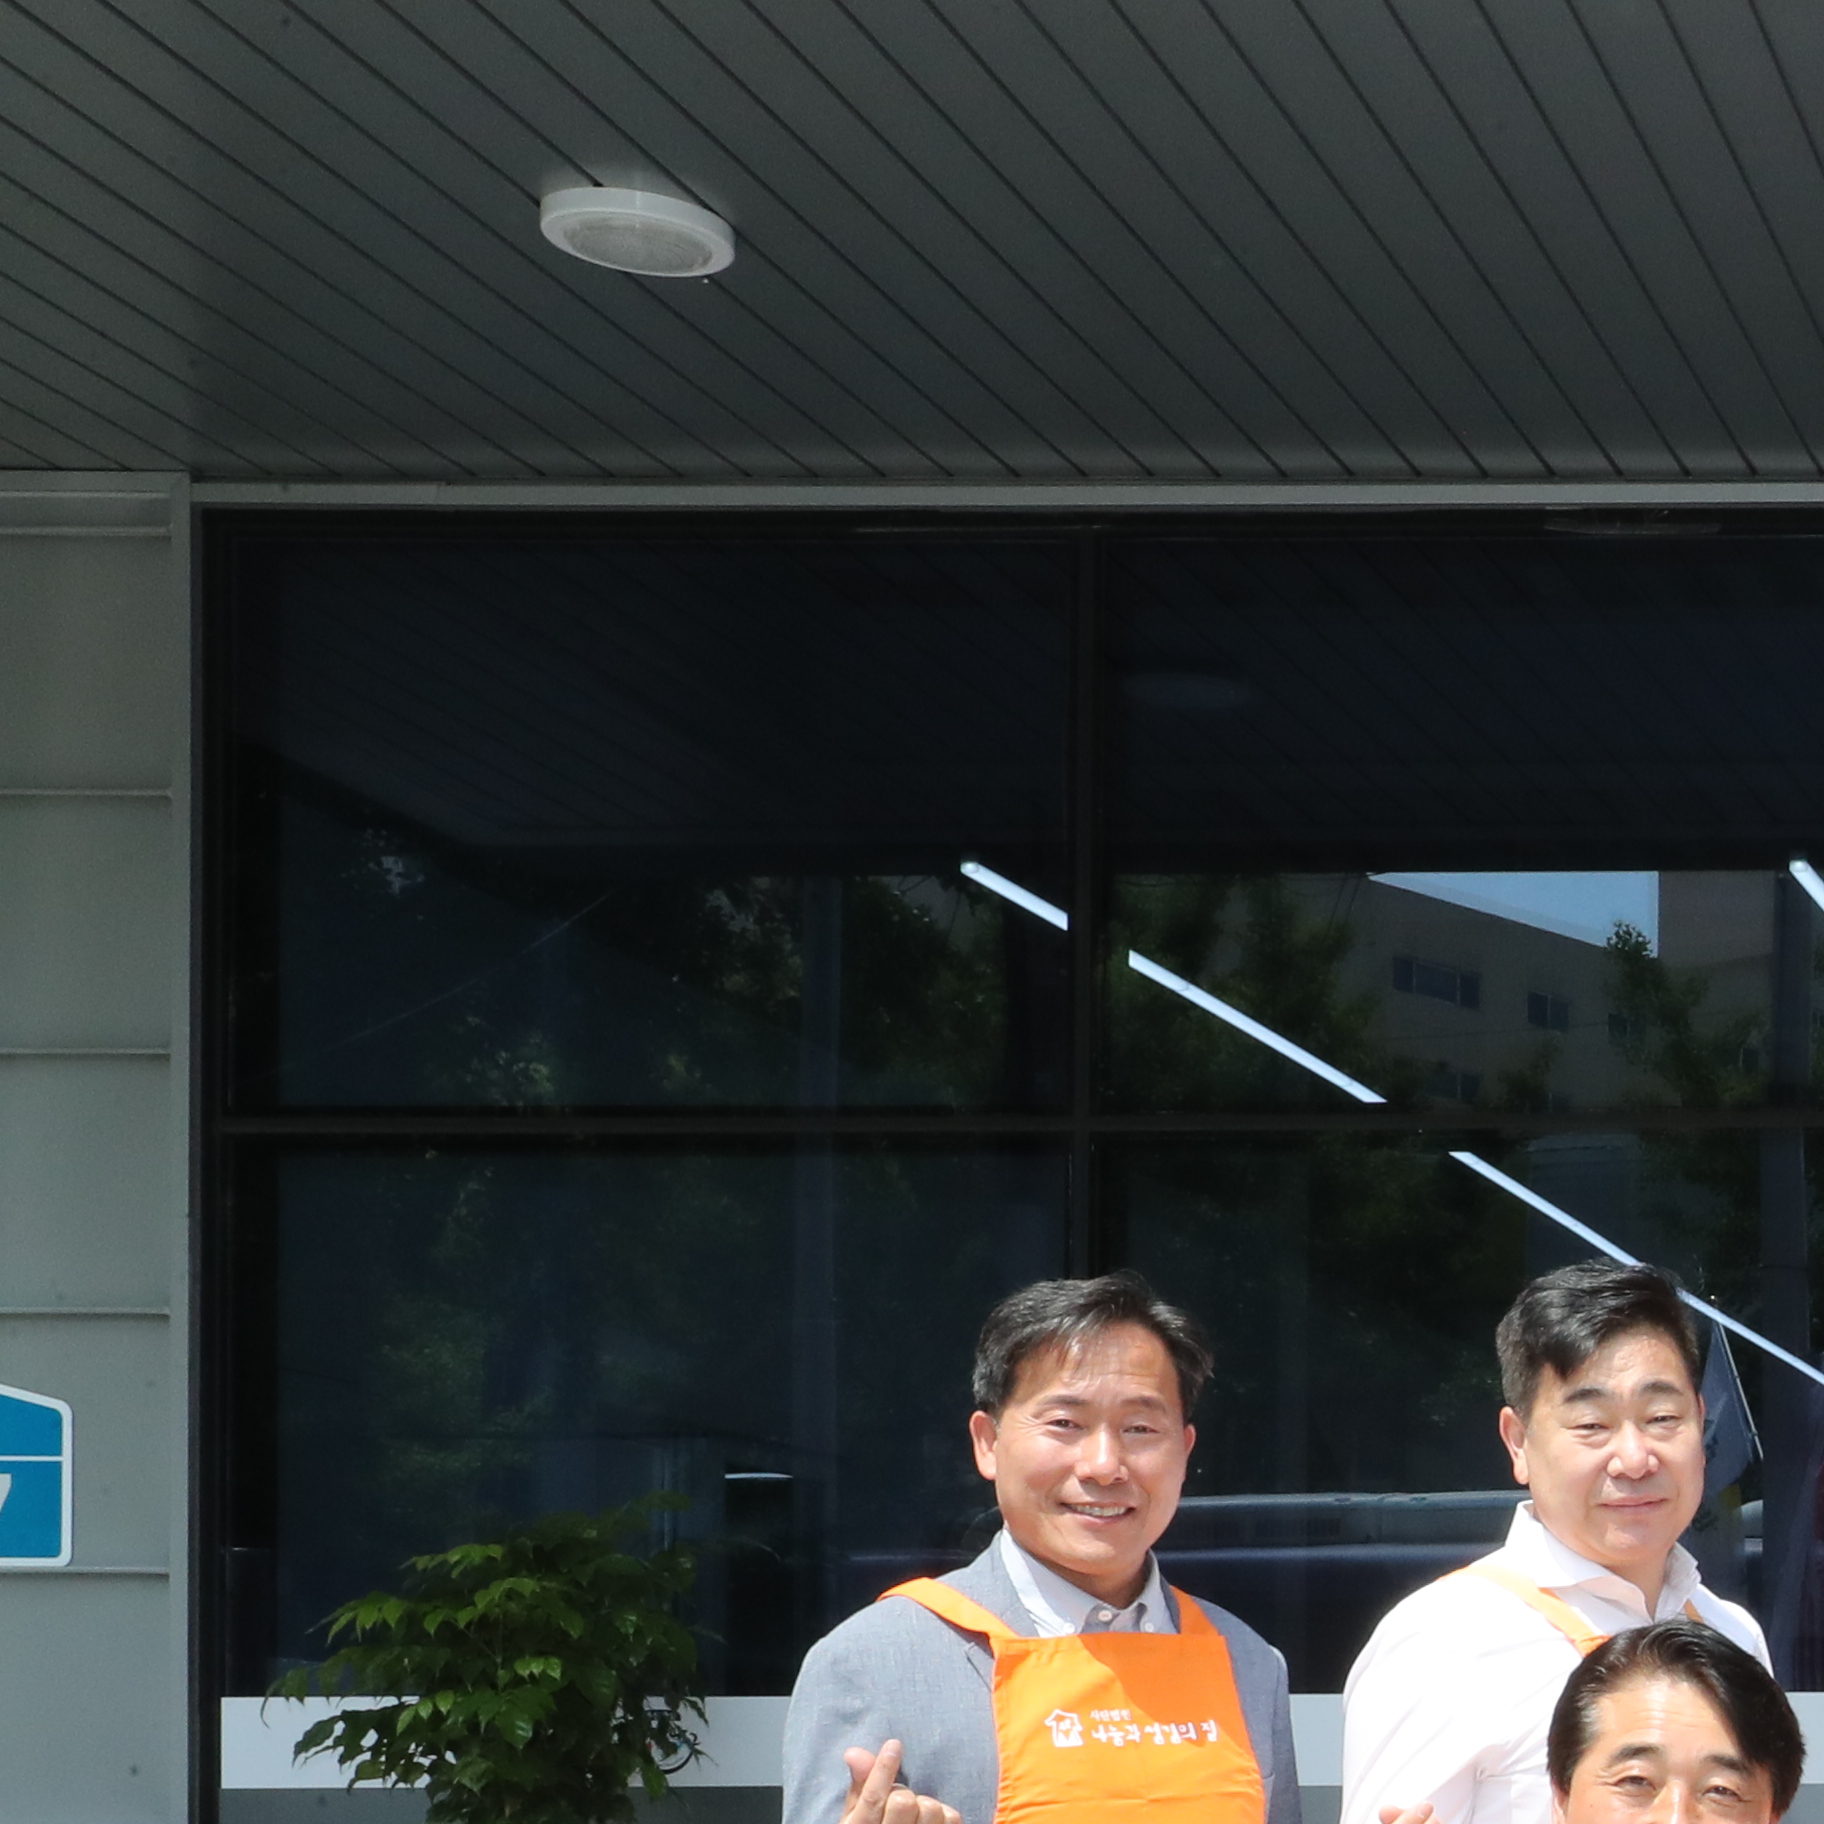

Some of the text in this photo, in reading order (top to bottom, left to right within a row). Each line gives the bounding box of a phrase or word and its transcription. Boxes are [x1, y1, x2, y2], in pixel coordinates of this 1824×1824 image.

[1091, 1719, 1218, 1746] 나눔과 섬김의 집
